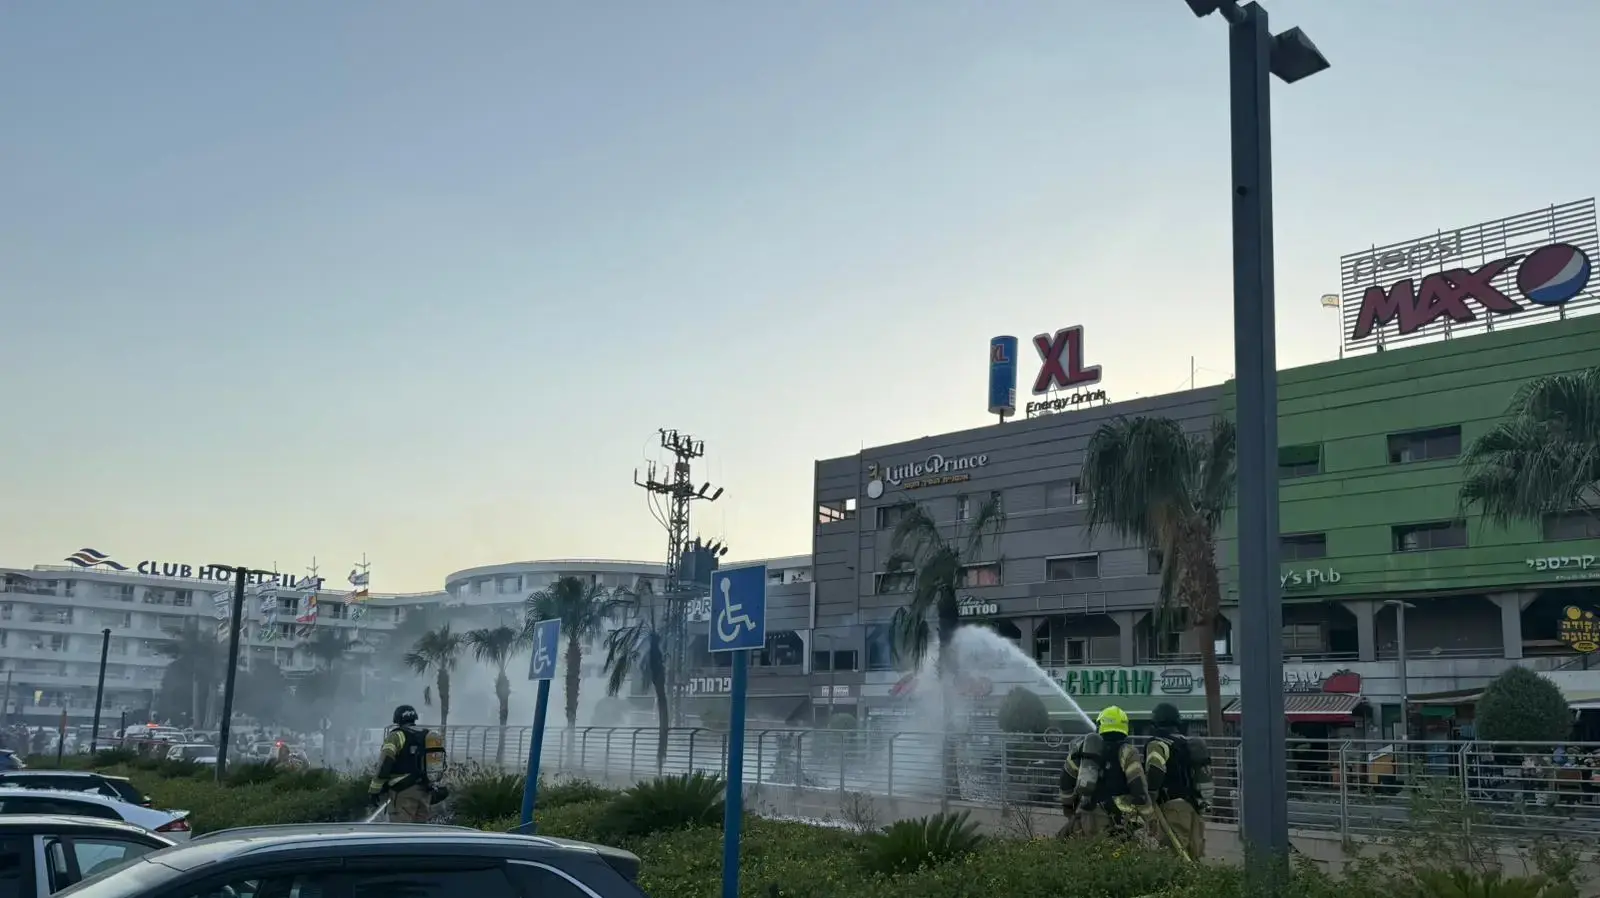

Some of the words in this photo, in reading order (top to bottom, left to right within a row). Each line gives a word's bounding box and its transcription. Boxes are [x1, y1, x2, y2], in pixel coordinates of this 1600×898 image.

[1352, 231, 1462, 283] pepsi
[1351, 254, 1526, 340] MAX
[990, 344, 1009, 363] XL
[1032, 324, 1102, 395] XL
[1026, 397, 1070, 413] Energy
[1071, 389, 1106, 404] Drink
[886, 462, 922, 485] Little
[925, 454, 988, 473] Prince
[137, 560, 192, 577] CLUB
[199, 566, 263, 583] HOEL
[274, 573, 326, 591] EILT
[1280, 570, 1302, 588] y's
[1306, 567, 1341, 585] Pub
[1526, 555, 1596, 571] קריספי
[1065, 668, 1155, 697] CAPTAIN
[1160, 676, 1193, 687] CAPTAIN
